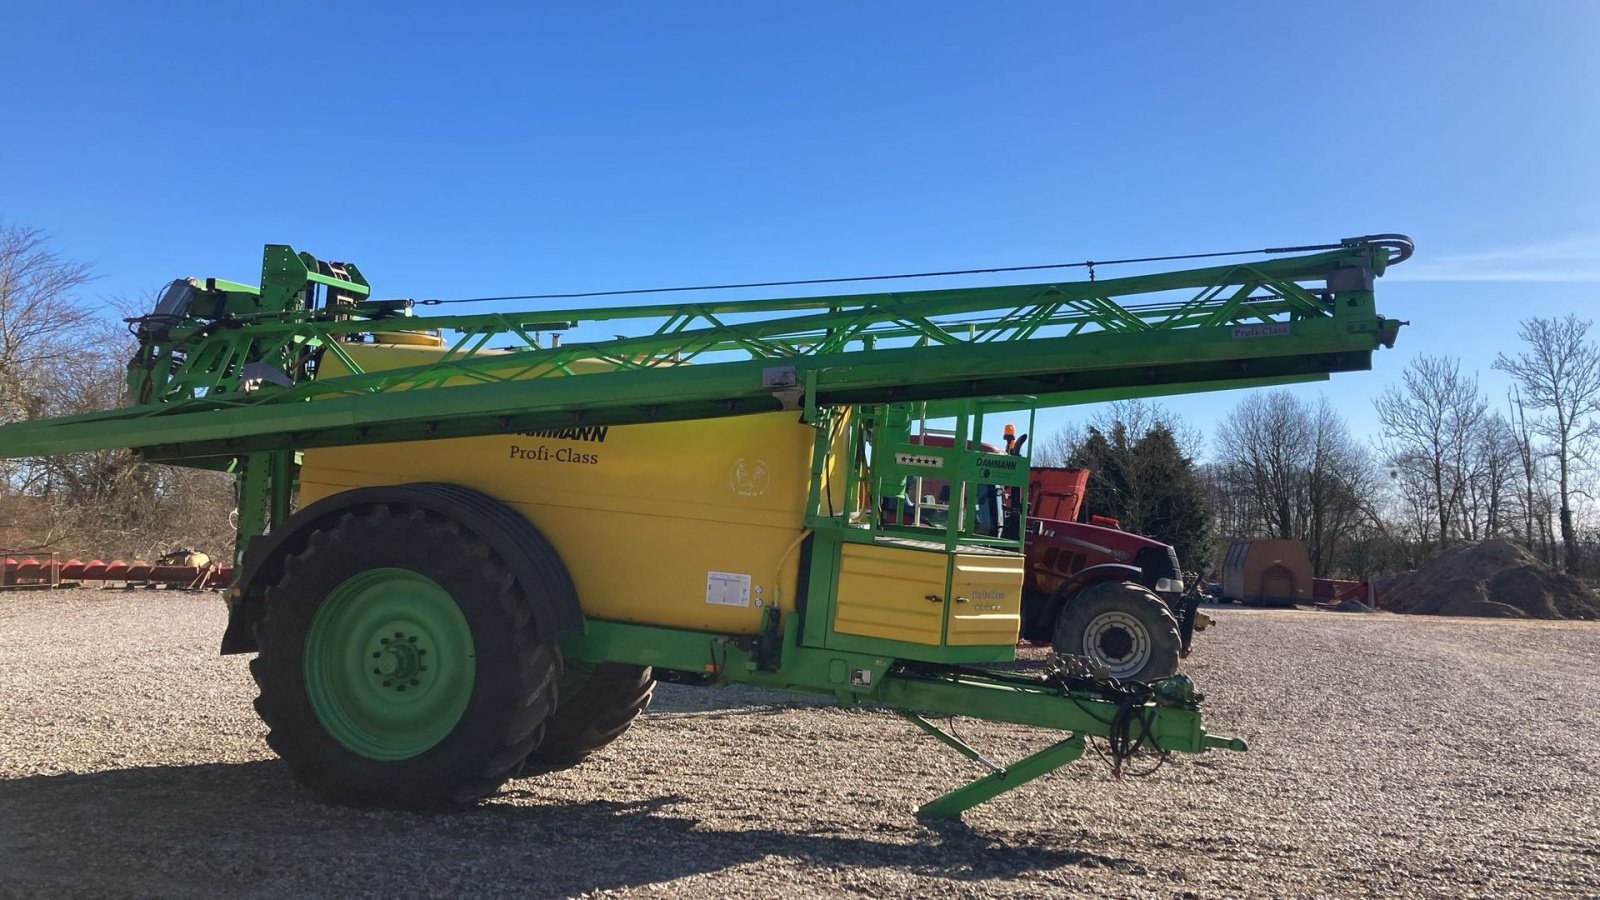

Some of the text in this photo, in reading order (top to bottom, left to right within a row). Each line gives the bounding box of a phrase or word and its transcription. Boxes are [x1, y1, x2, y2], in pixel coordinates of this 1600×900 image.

[514, 425, 608, 442] MANN
[509, 445, 598, 464] Profi-Class
[976, 457, 1017, 470] DAMMANN
